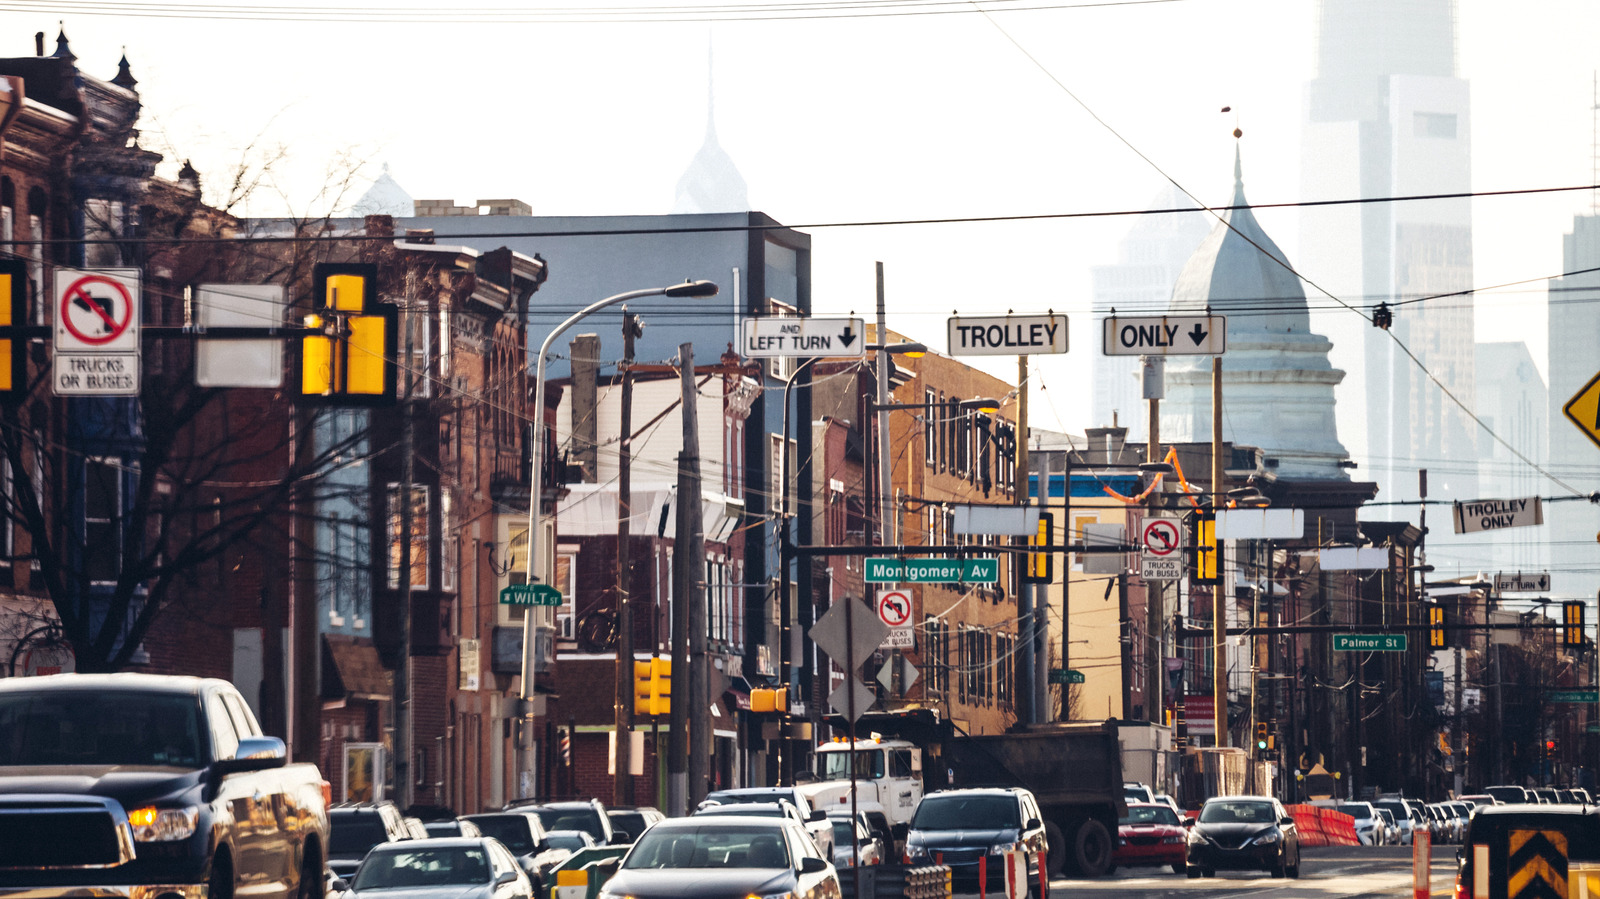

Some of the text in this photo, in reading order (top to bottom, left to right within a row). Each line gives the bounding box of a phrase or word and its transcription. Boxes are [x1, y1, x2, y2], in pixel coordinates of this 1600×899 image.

[780, 325, 800, 334] AND
[956, 324, 1058, 347] TROLLEY
[1120, 325, 1178, 347] ONLY
[750, 336, 830, 350] LEFT TURN
[70, 358, 124, 372] TRUCKS
[60, 374, 133, 388] OR BUSES
[1466, 500, 1526, 516] TROLLEY
[1481, 514, 1514, 528] ONLY
[873, 564, 988, 580] Montgomery Av
[514, 592, 547, 604] WILT
[1341, 639, 1397, 647] Palmer St
